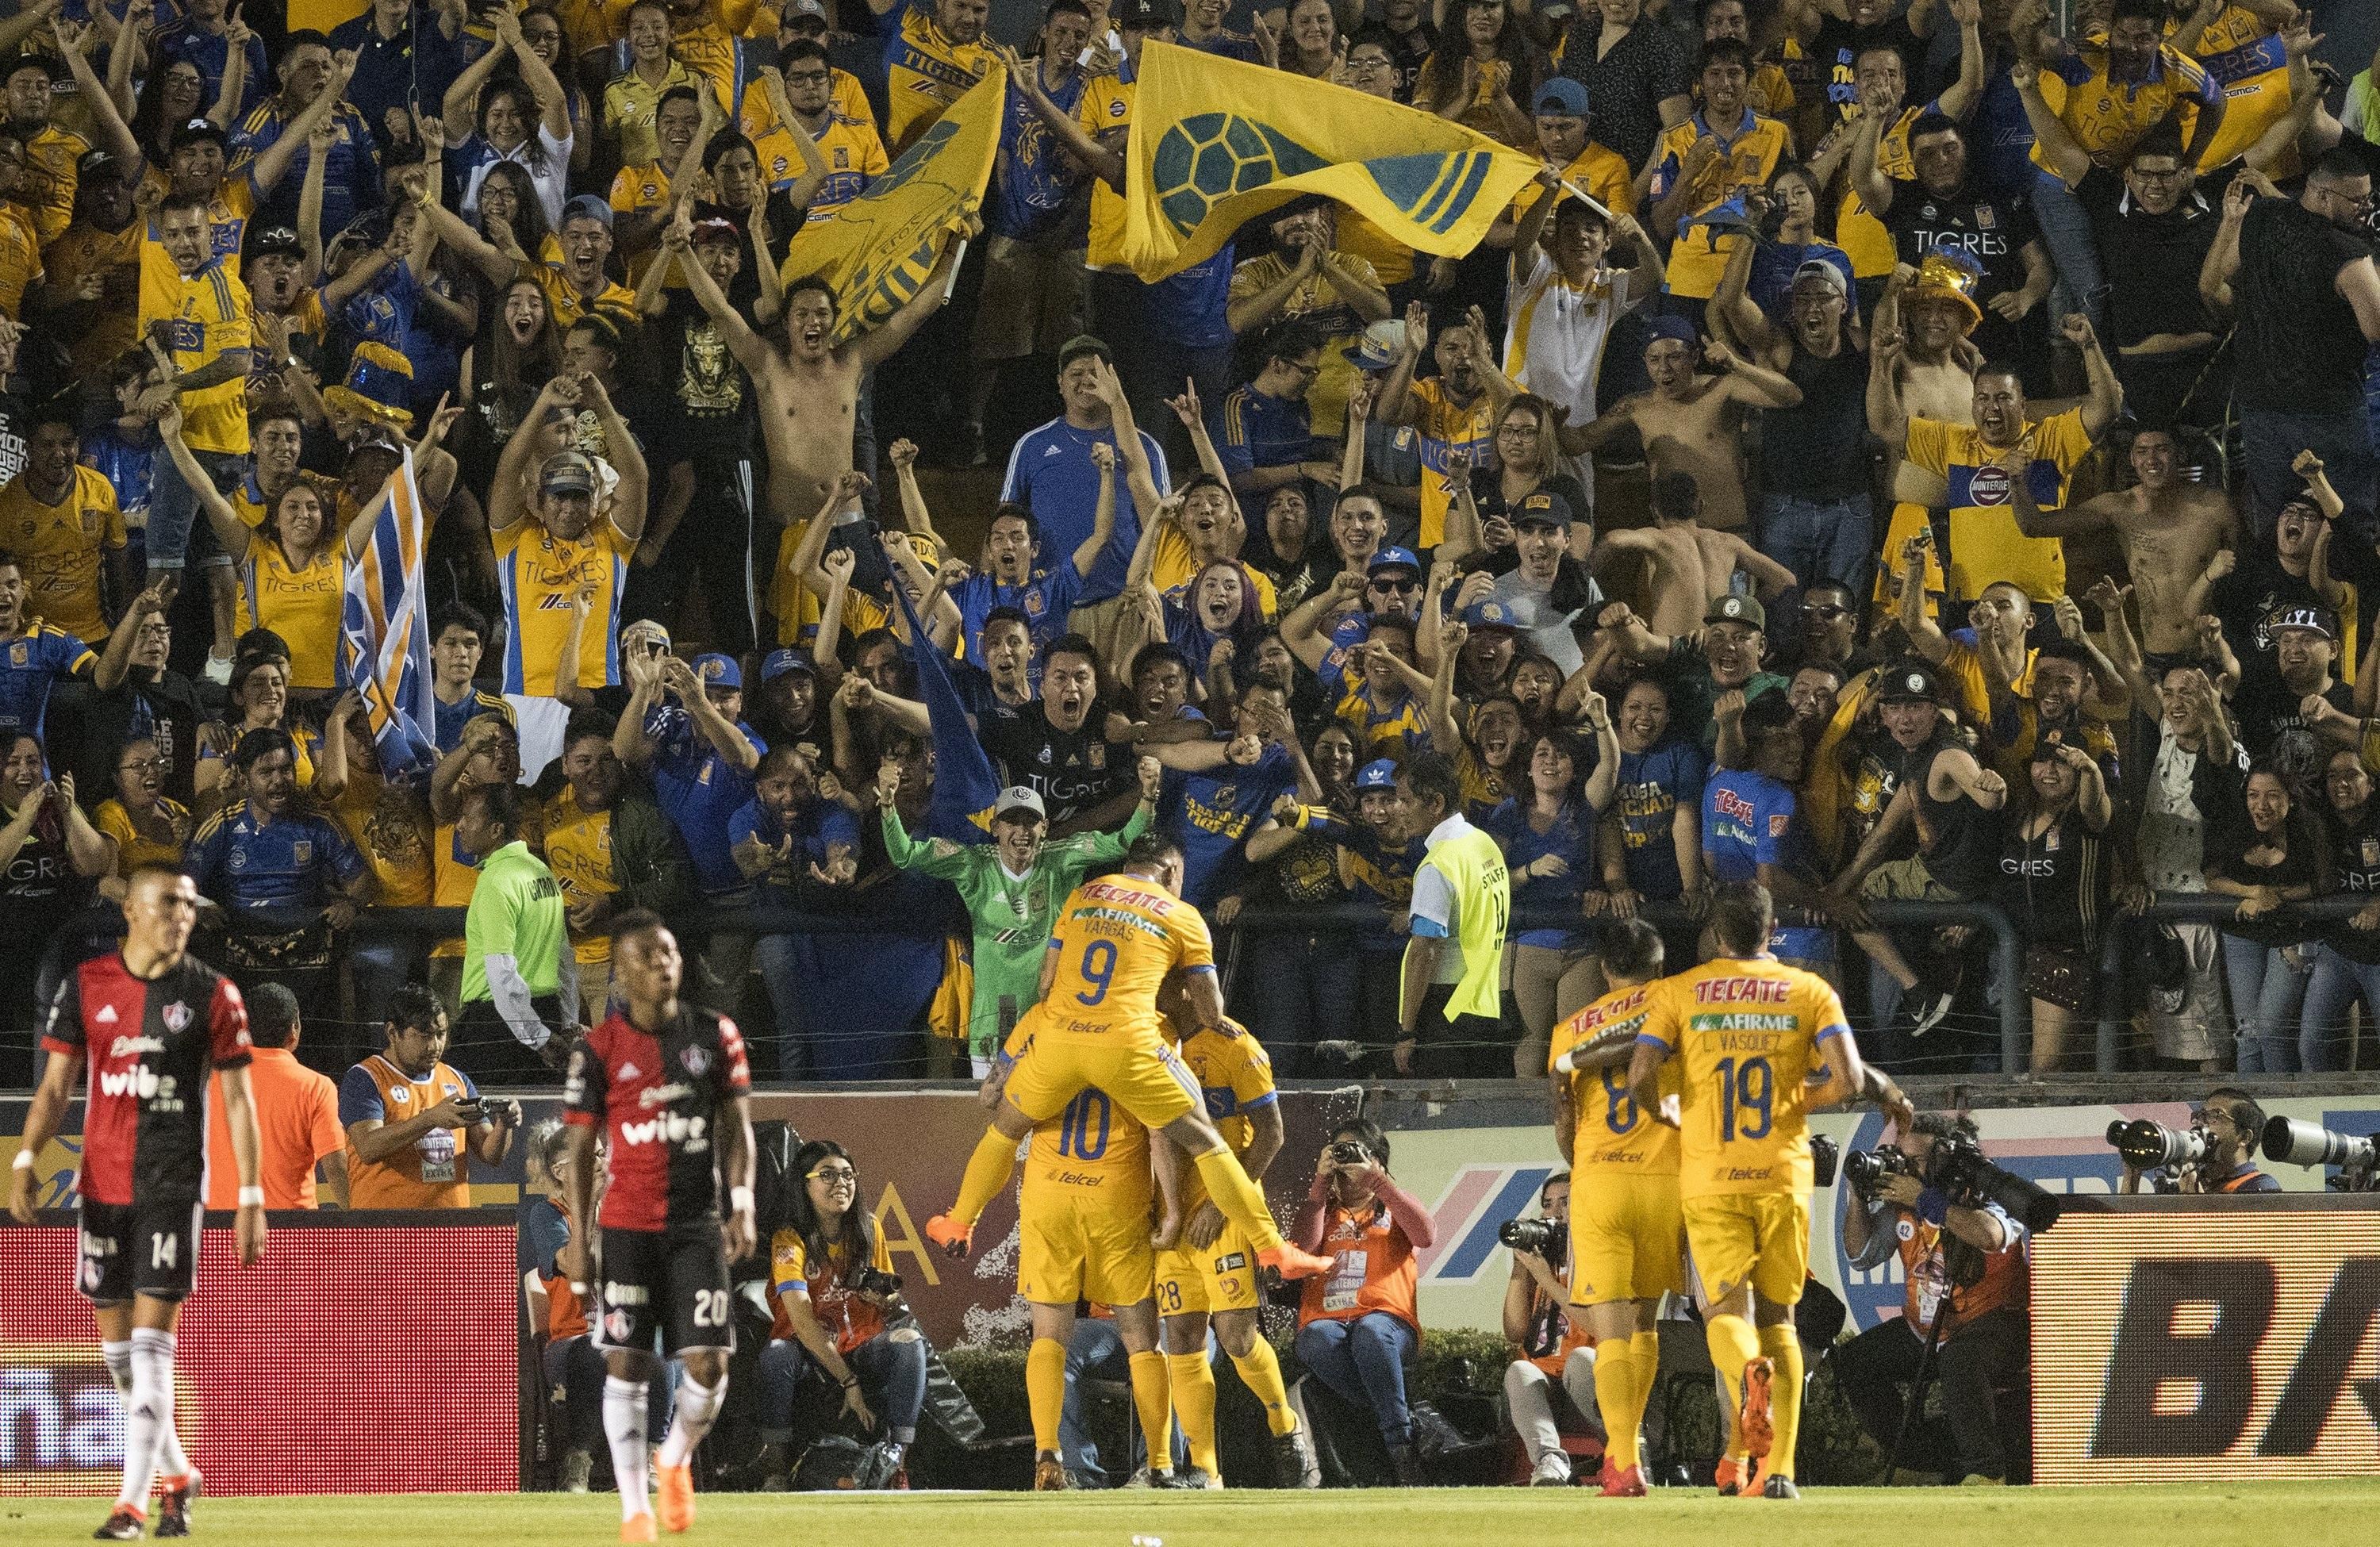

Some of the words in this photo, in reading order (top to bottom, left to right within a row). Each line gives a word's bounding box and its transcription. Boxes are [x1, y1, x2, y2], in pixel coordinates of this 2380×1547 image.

[1914, 230, 2007, 255] TIGRES
[525, 557, 608, 585] TIGRES
[266, 576, 337, 593] TIGRES
[1482, 866, 1505, 889] STAFF
[2001, 858, 2055, 877] GRES
[1079, 884, 1175, 917] TECATE
[1084, 920, 1135, 942] VARGAS
[1091, 907, 1172, 939] AFIRME
[1076, 939, 1119, 1007] 9
[1695, 977, 1791, 1005] TECATE
[1067, 1019, 1111, 1034] telcel
[1722, 1015, 1796, 1031] AFIRME
[1719, 1032, 1782, 1054] VASQUEZ
[1603, 1063, 1640, 1134] 8
[1716, 1056, 1772, 1142] 19
[1059, 1088, 1111, 1161] 10
[1057, 1171, 1105, 1188] telcel
[1727, 1167, 1772, 1181] telcel
[1898, 1225, 1910, 1236] 42
[150, 1232, 177, 1270] 14
[693, 1288, 729, 1327] 20
[1157, 1279, 1183, 1313] 28
